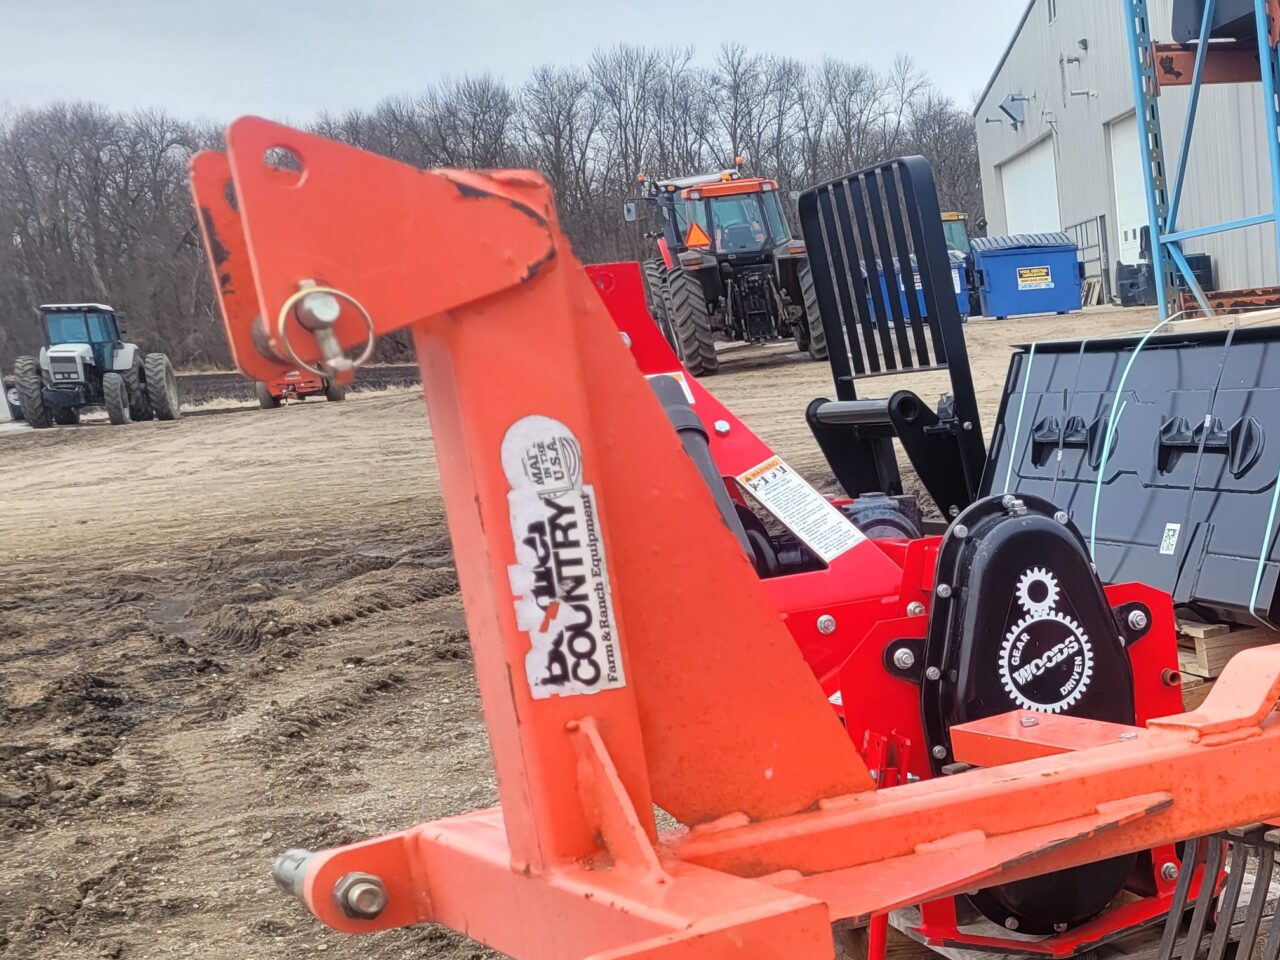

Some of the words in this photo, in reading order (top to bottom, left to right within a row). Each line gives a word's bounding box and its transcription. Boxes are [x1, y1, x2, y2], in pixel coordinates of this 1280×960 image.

[543, 467, 552, 479] IN
[580, 493, 603, 579] Equipment
[545, 498, 601, 686] COUNTRY
[594, 582, 611, 630] Ranch
[601, 629, 611, 641] &
[1011, 632, 1030, 666] GEAR
[604, 644, 618, 683] Farm
[1013, 635, 1080, 686] WOODS
[1060, 656, 1082, 696] DRIVEN
